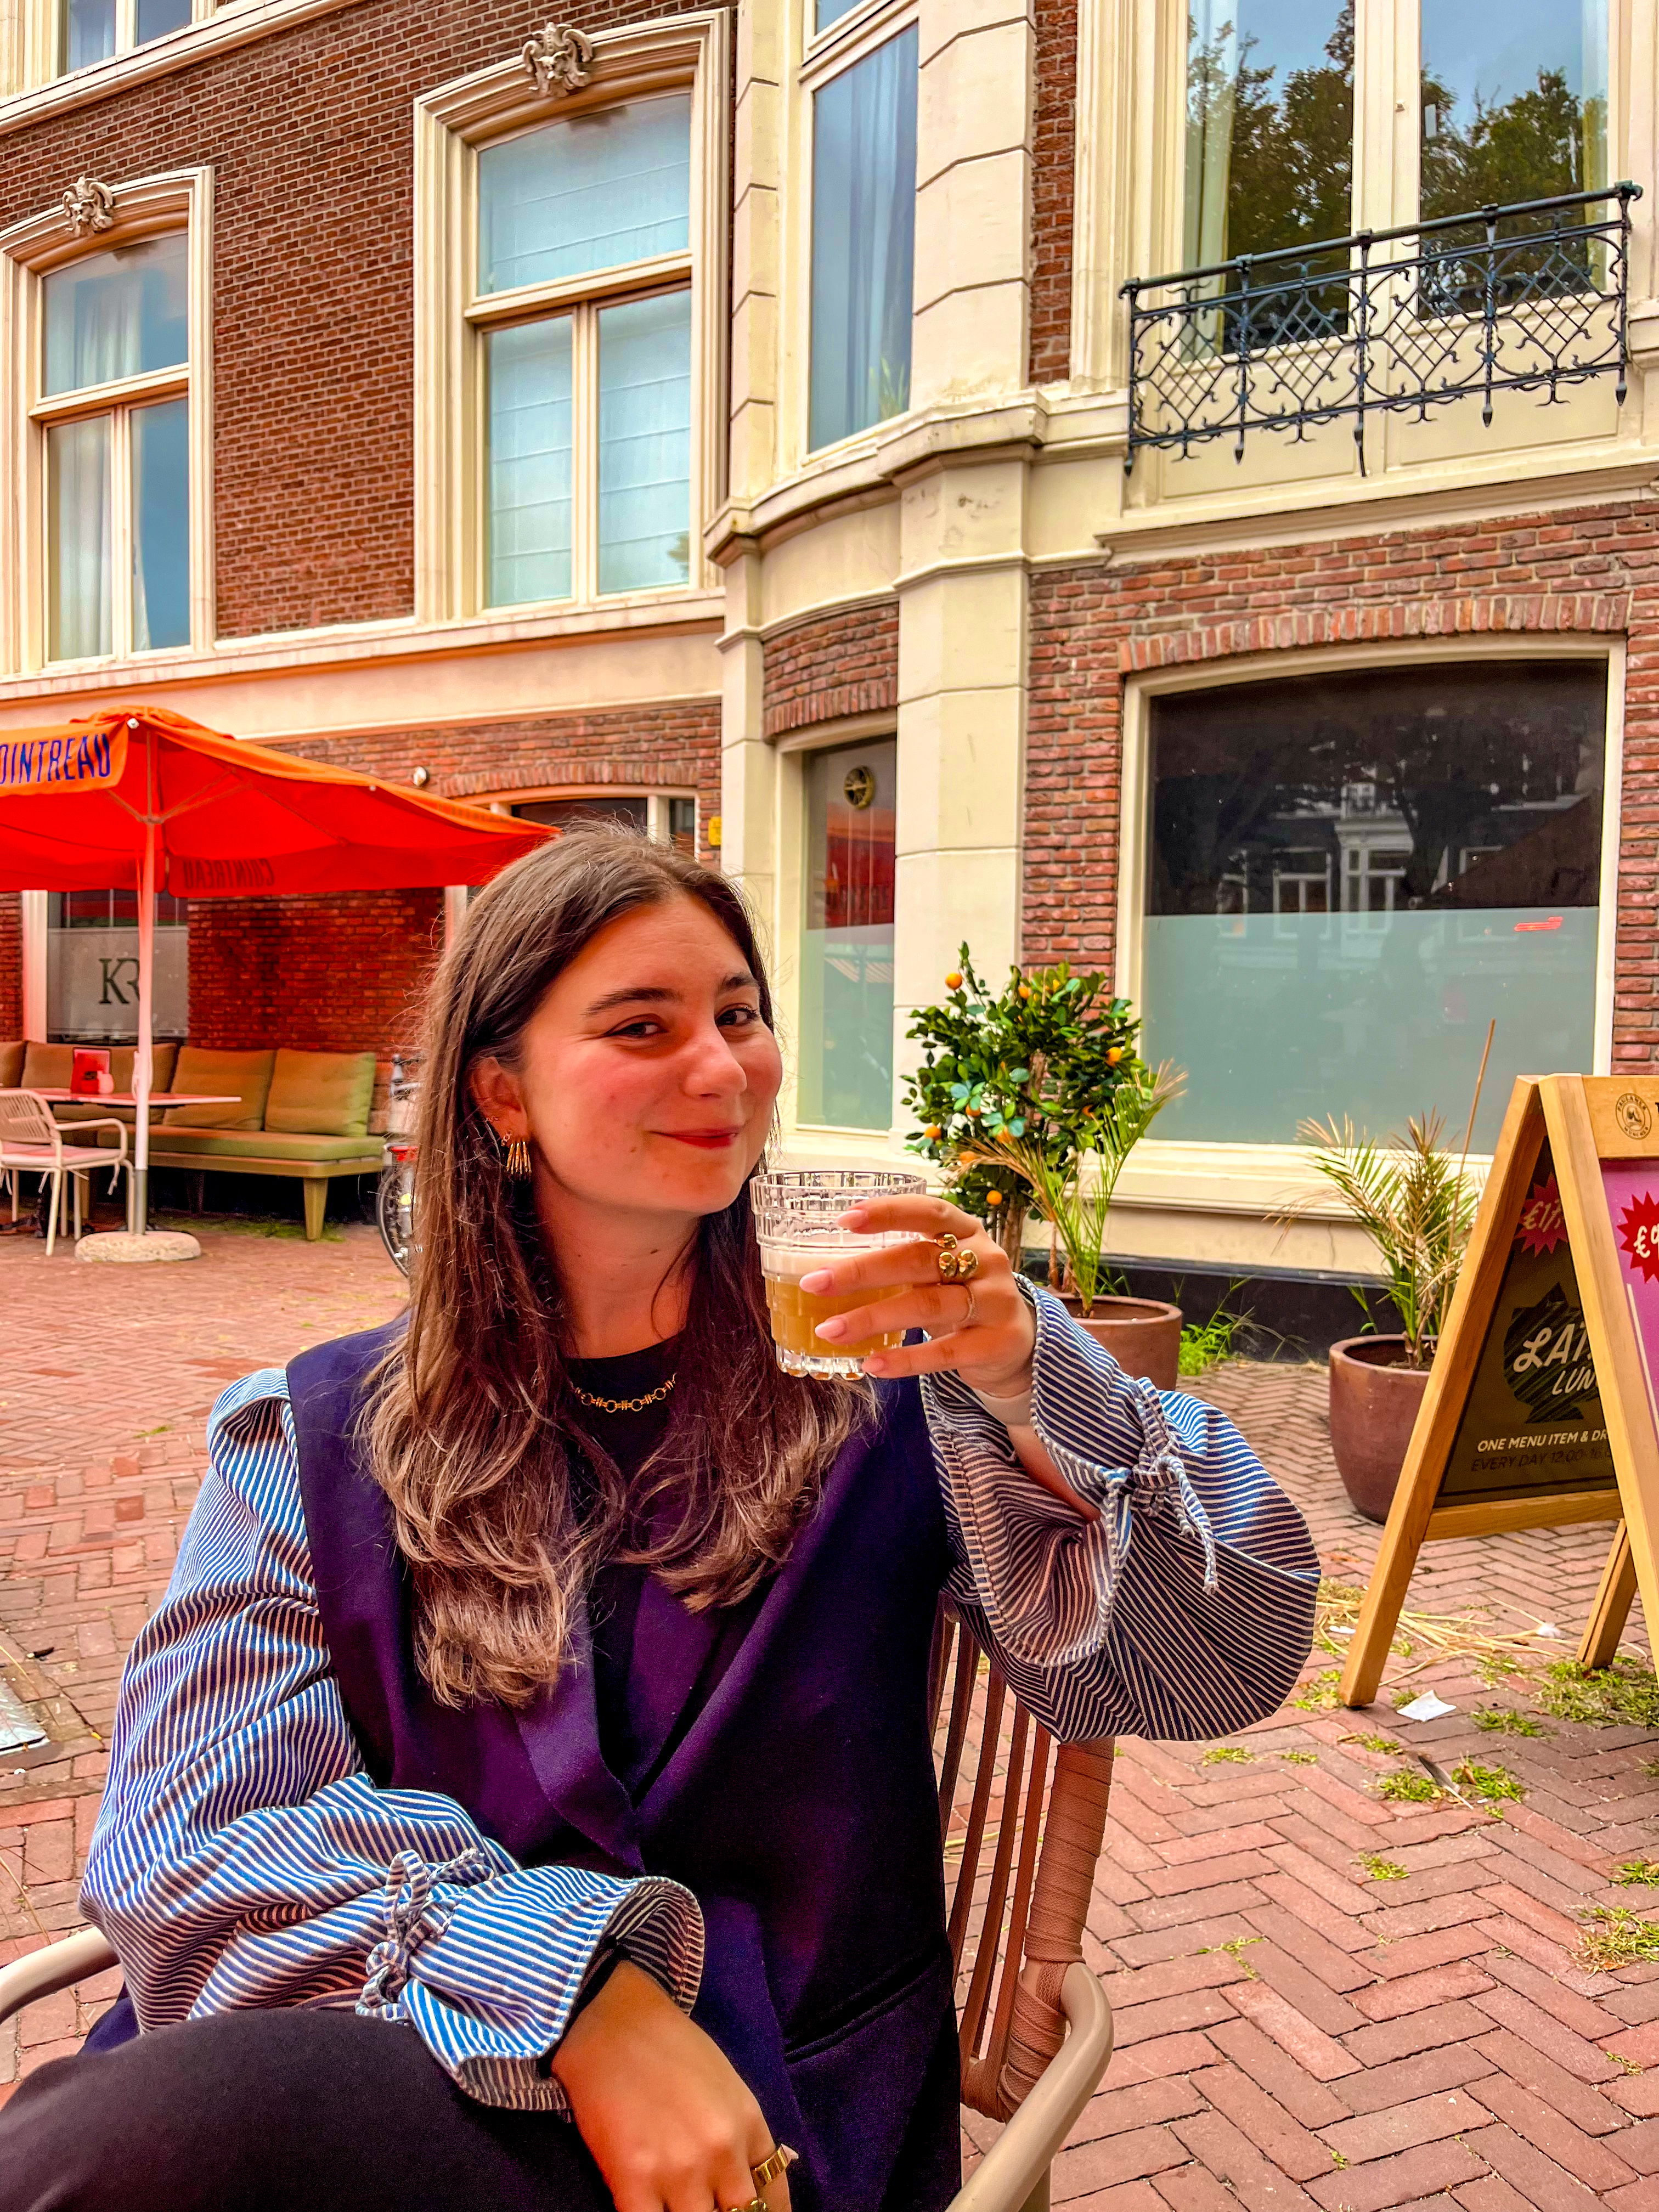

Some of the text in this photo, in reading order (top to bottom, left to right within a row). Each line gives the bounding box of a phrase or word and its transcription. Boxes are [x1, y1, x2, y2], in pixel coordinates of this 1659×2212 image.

[1477, 1438, 1506, 1452] ONE
[1508, 1434, 1547, 1449] MENU
[1548, 1431, 1578, 1446] ITEM
[1580, 1430, 1589, 1442] &
[1471, 1457, 1516, 1471] EVERY
[1518, 1453, 1548, 1467] DAY
